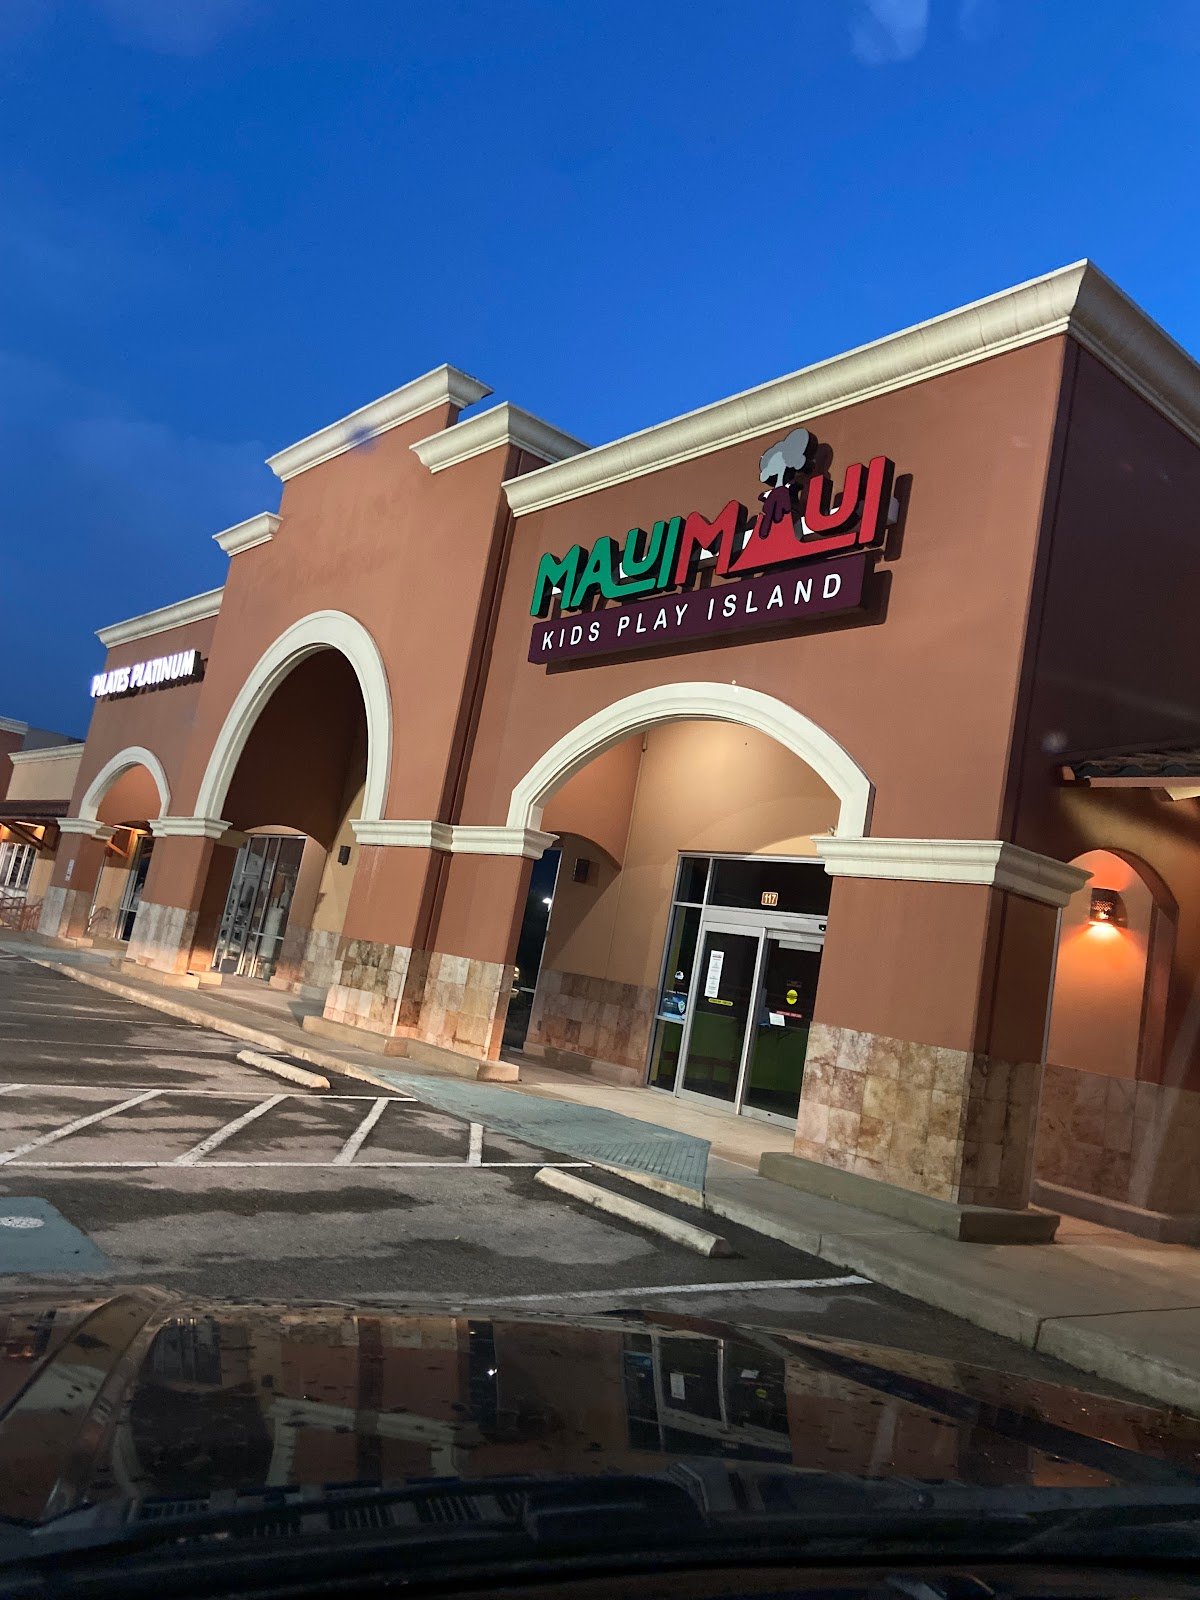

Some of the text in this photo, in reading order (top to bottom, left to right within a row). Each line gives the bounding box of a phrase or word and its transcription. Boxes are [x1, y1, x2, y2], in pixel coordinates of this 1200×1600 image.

[541, 573, 842, 650] KIDS PLAY ISLAND
[90, 649, 195, 697] PILATES PLATINUM
[764, 894, 776, 904] 117
